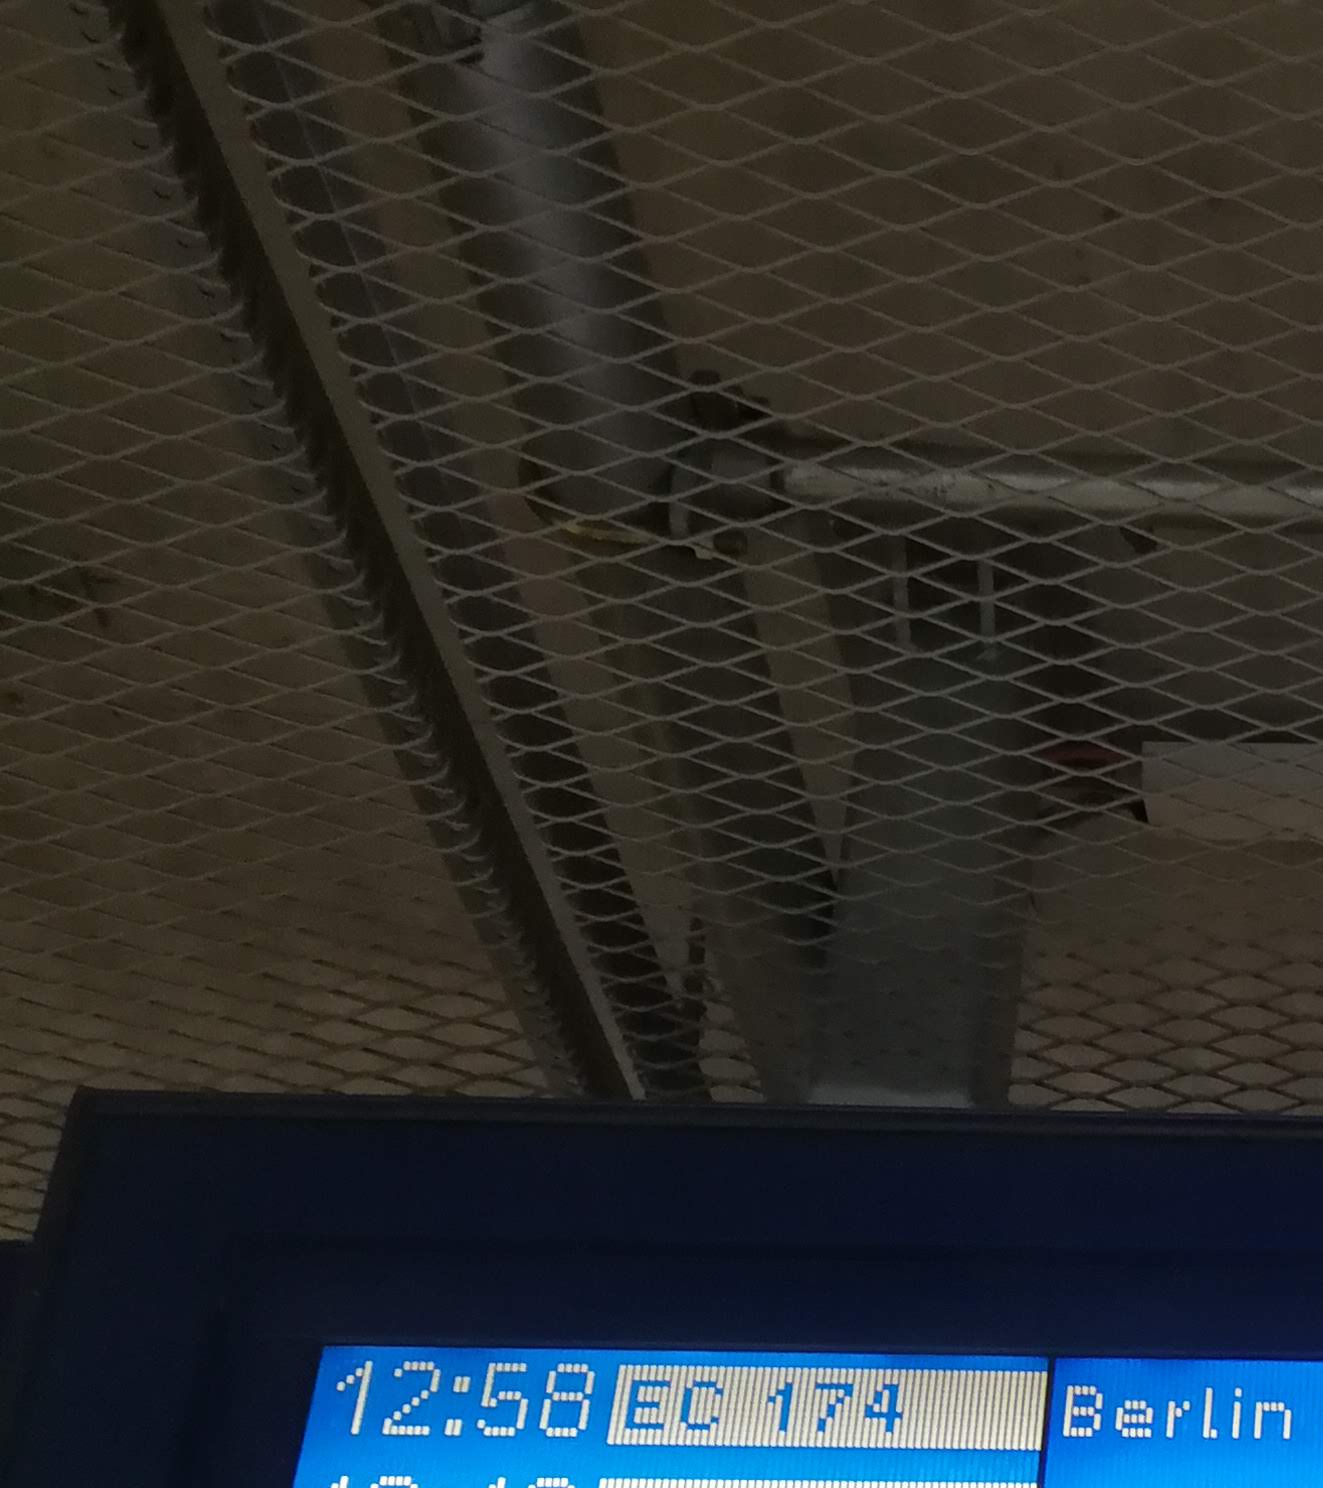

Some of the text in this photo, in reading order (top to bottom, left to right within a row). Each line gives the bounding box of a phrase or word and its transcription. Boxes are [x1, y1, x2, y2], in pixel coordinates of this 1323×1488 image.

[337, 1362, 594, 1437] 12:58
[624, 1380, 724, 1432] EC
[766, 1382, 905, 1437] 174
[1064, 1386, 1291, 1439] Berlin
